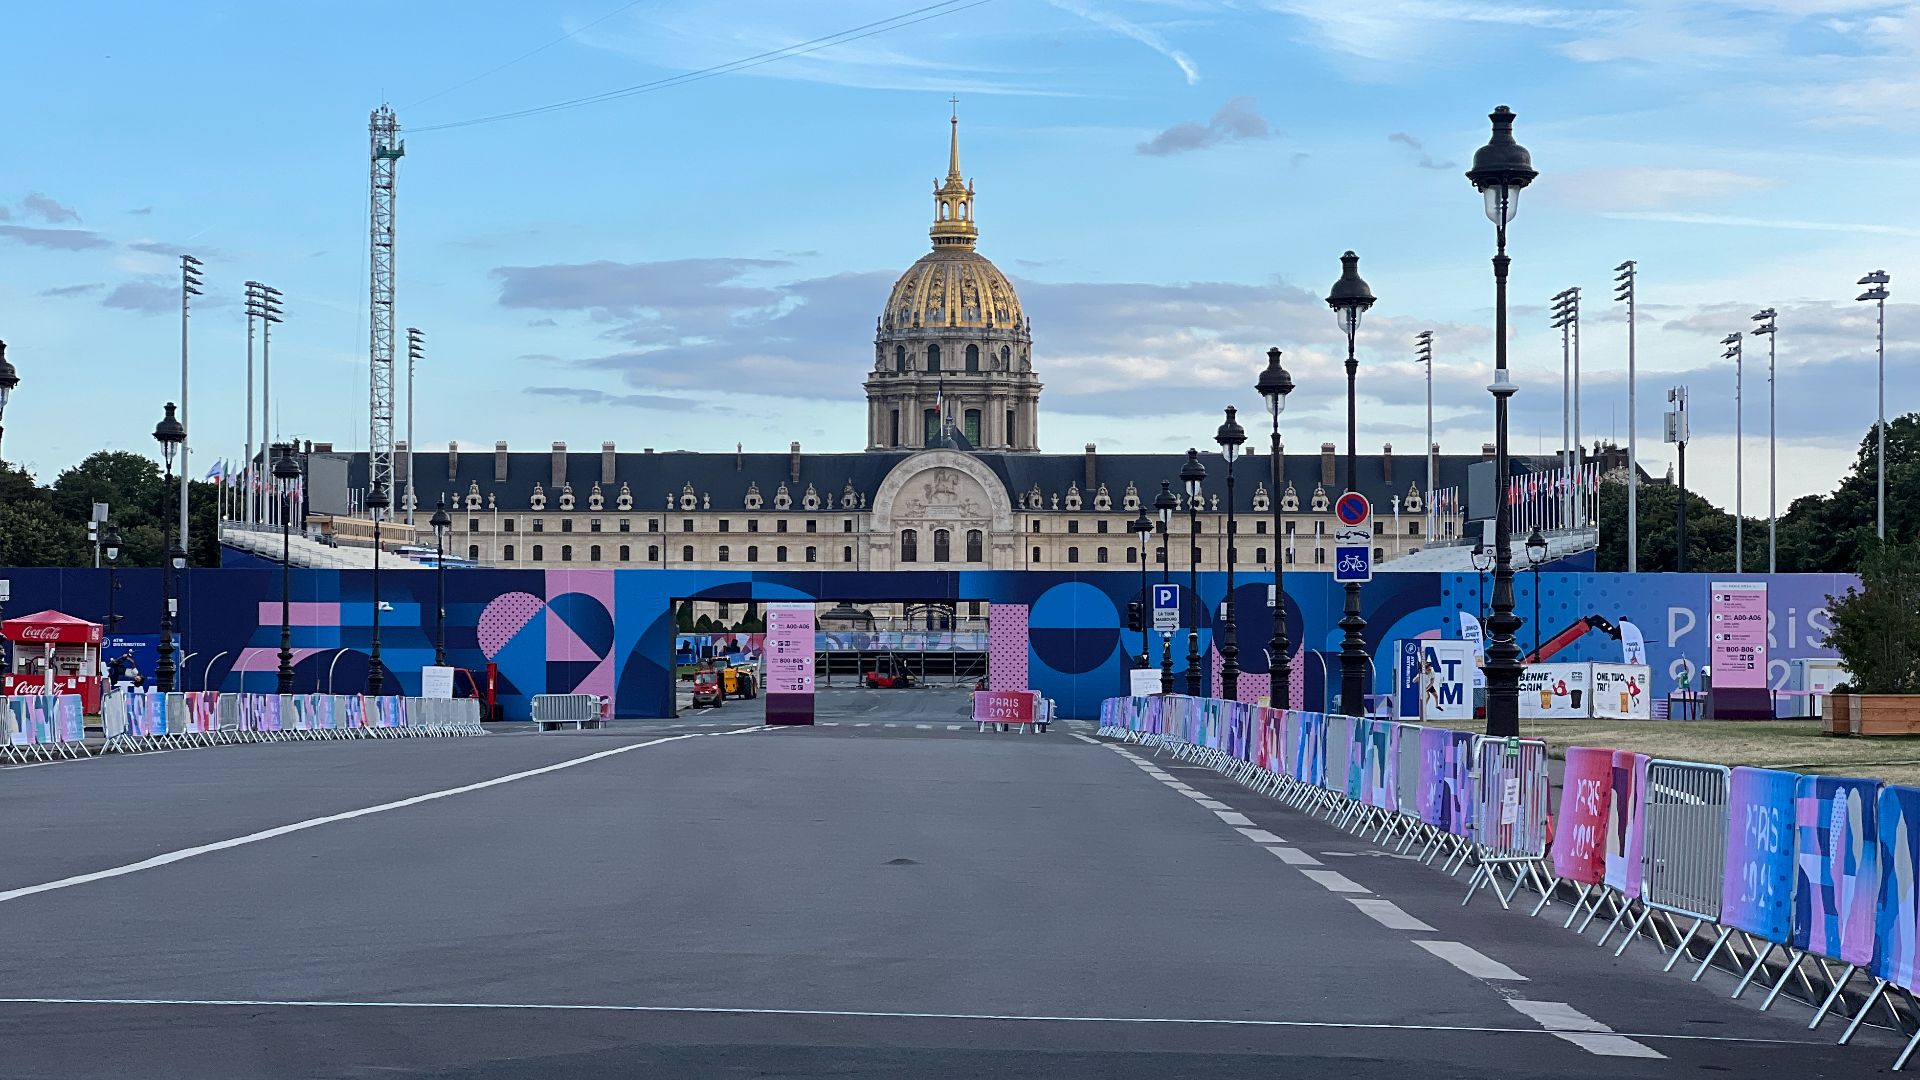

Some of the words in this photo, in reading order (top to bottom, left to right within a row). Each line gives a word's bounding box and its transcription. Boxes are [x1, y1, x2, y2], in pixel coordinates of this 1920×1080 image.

[1160, 589, 1172, 606] P
[989, 697, 1019, 708] PARIS
[989, 708, 1019, 718] 2024
